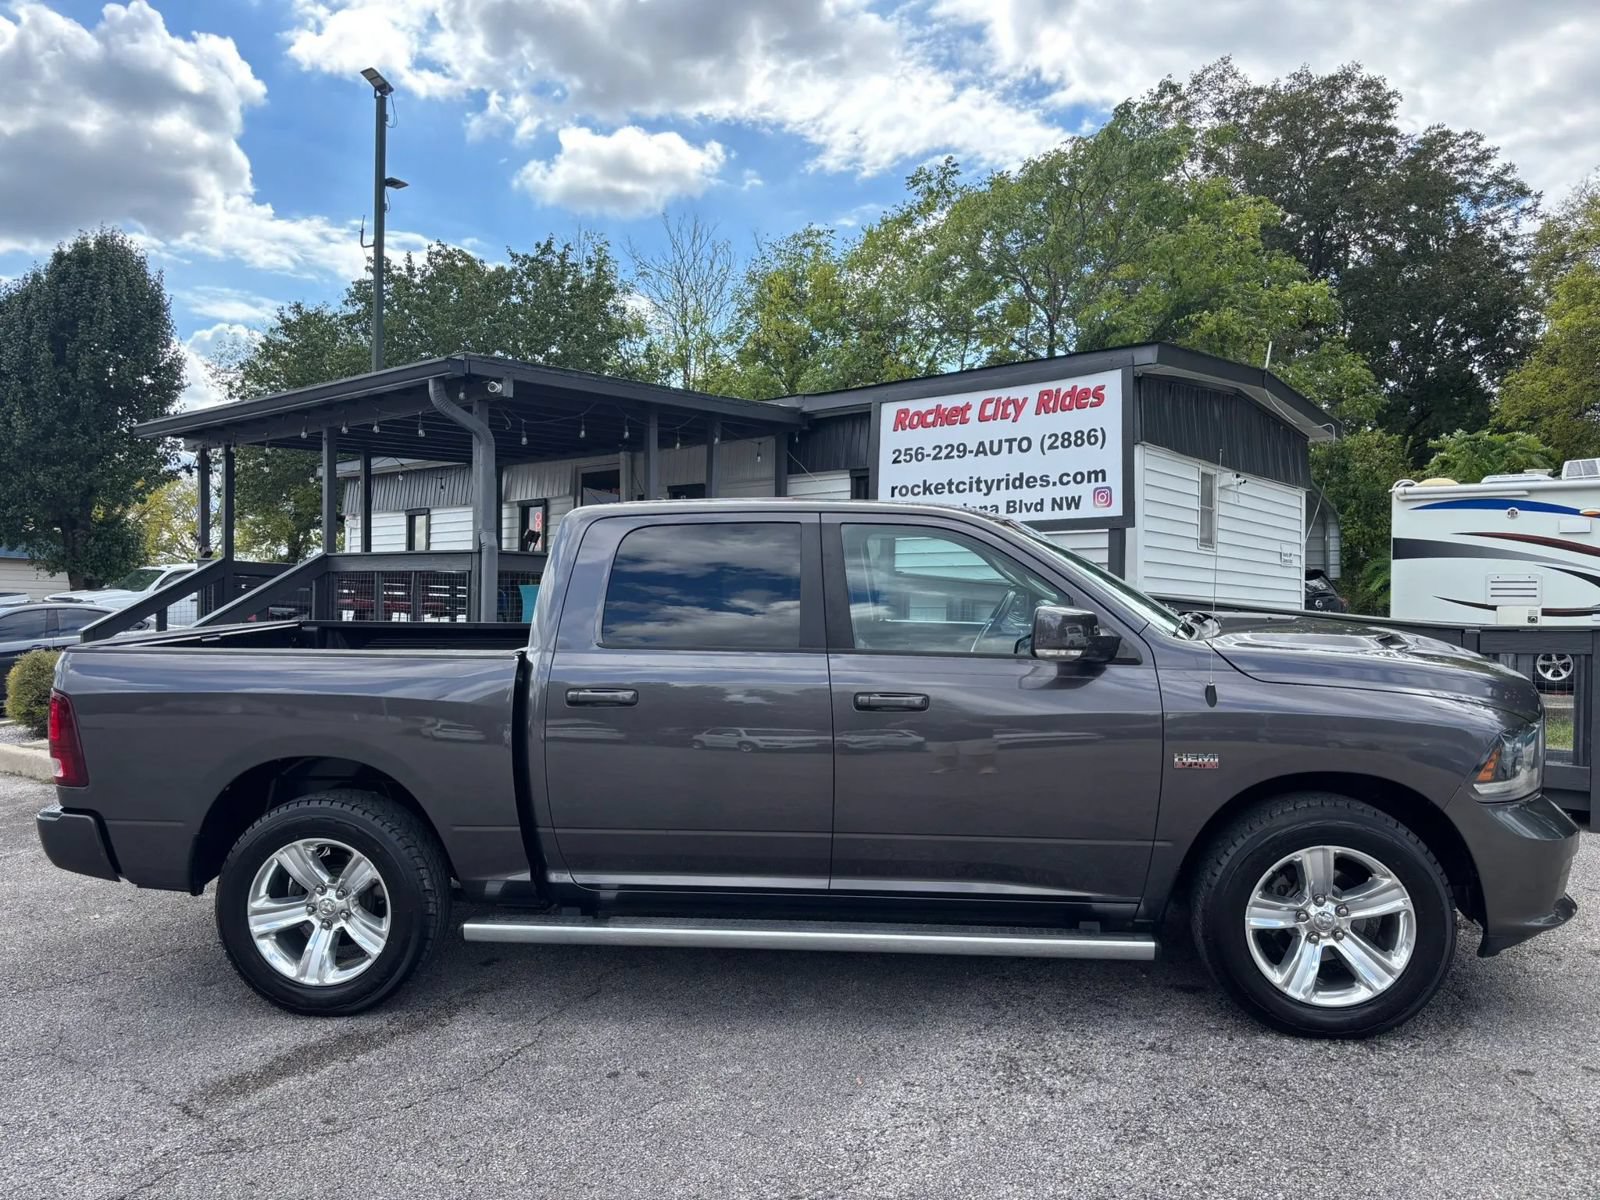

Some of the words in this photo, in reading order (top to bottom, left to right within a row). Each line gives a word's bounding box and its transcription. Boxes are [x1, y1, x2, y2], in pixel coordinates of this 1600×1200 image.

[892, 401, 972, 432] Rocket
[977, 396, 1028, 423] City
[1035, 384, 1106, 415] Rides
[891, 436, 1032, 465] 256-229-AUTO
[1040, 427, 1107, 455] (2886)
[890, 468, 1107, 498] rocketcityrides.com
[1006, 498, 1044, 514] Blvd
[1051, 495, 1082, 511] NW
